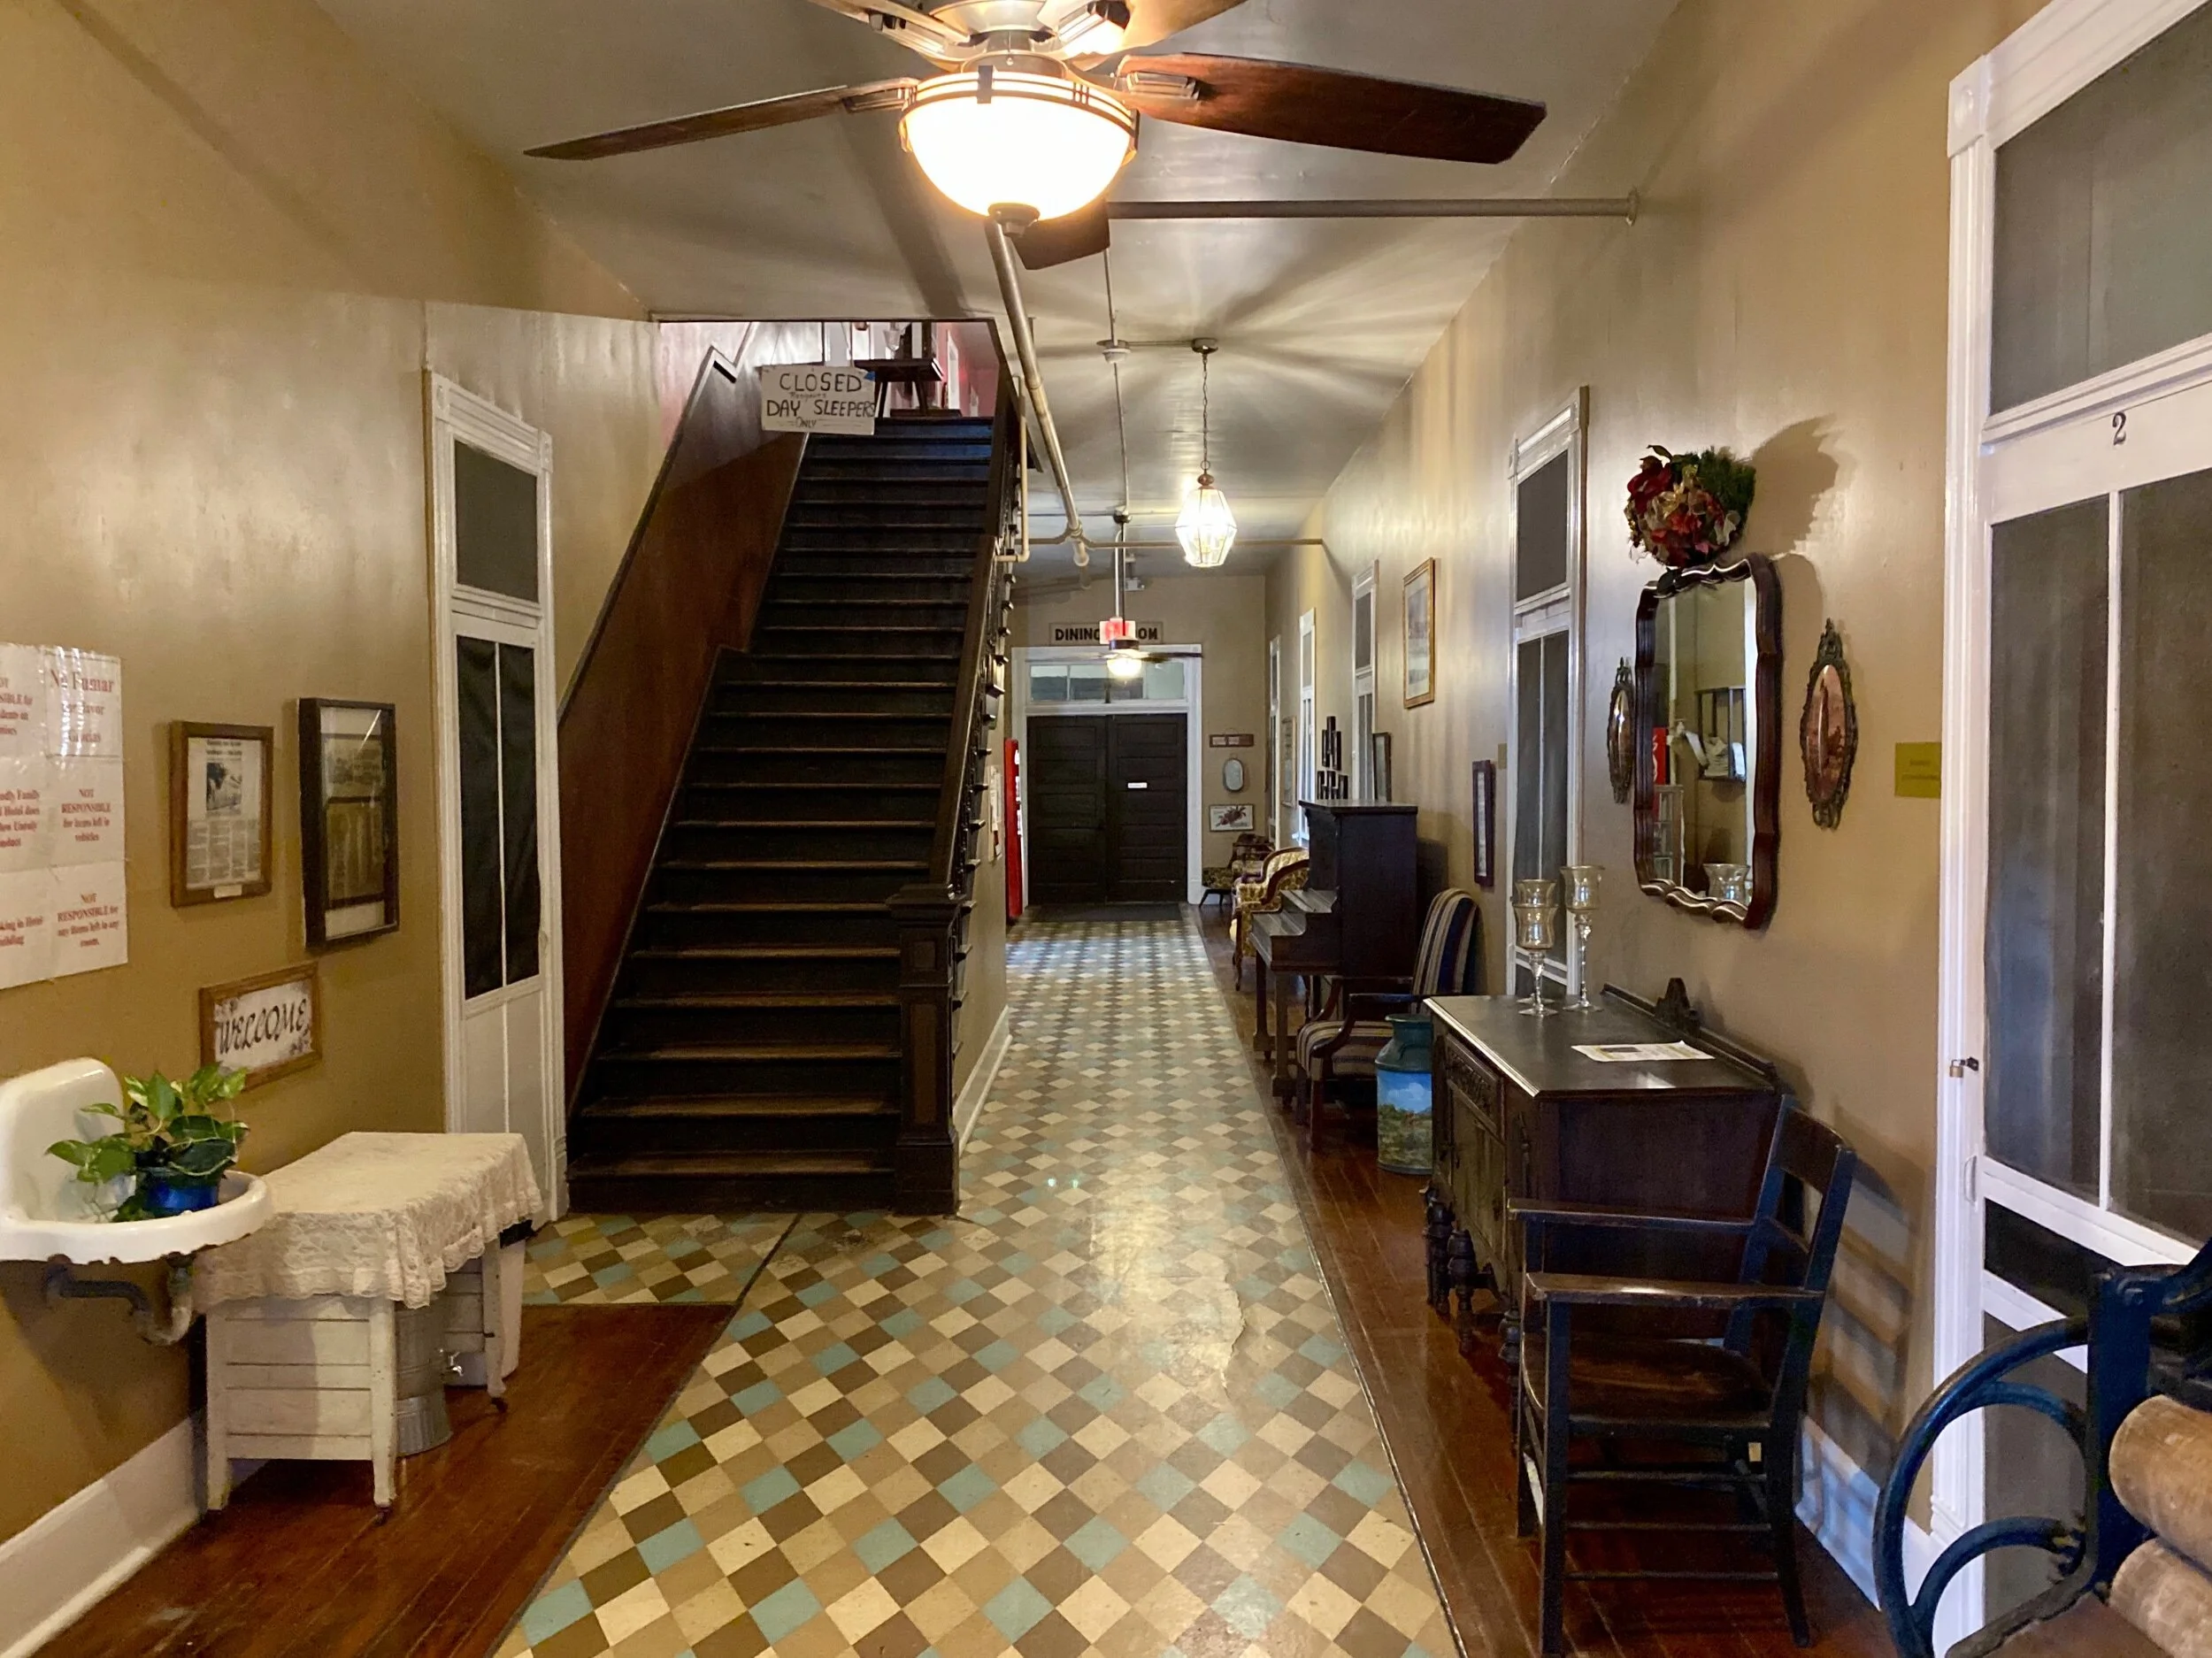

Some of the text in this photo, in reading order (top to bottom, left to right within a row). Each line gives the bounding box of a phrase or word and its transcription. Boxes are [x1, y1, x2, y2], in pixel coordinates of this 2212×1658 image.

[780, 372, 862, 392] CLOSED
[766, 399, 875, 418] DAY SLEEPERS
[797, 416, 817, 428] ONLY
[2112, 411, 2126, 446] 2
[61, 802, 111, 813] RESPONSIBLE
[58, 906, 108, 923] RESPONSIBLE
